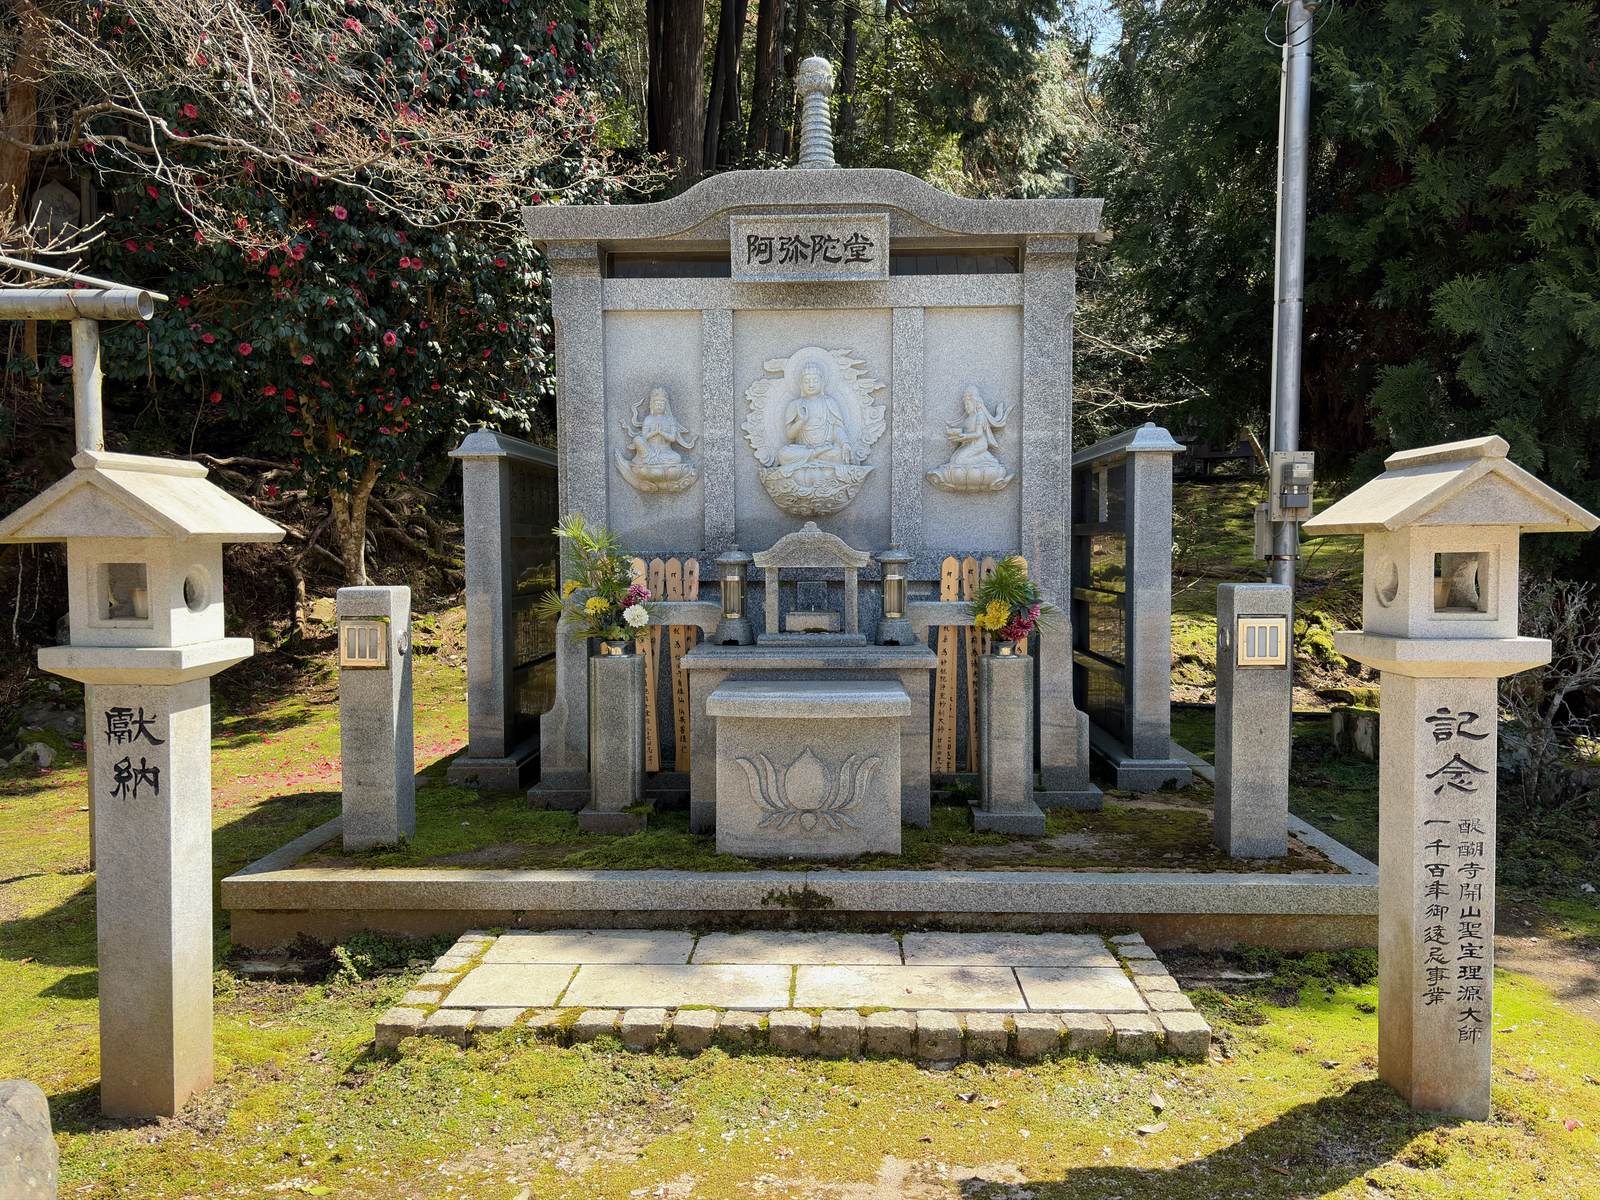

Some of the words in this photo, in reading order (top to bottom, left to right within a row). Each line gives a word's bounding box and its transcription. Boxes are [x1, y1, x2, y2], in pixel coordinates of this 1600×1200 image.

[746, 232, 874, 265] 阿弥陀堂
[1425, 707, 1490, 796] 記念
